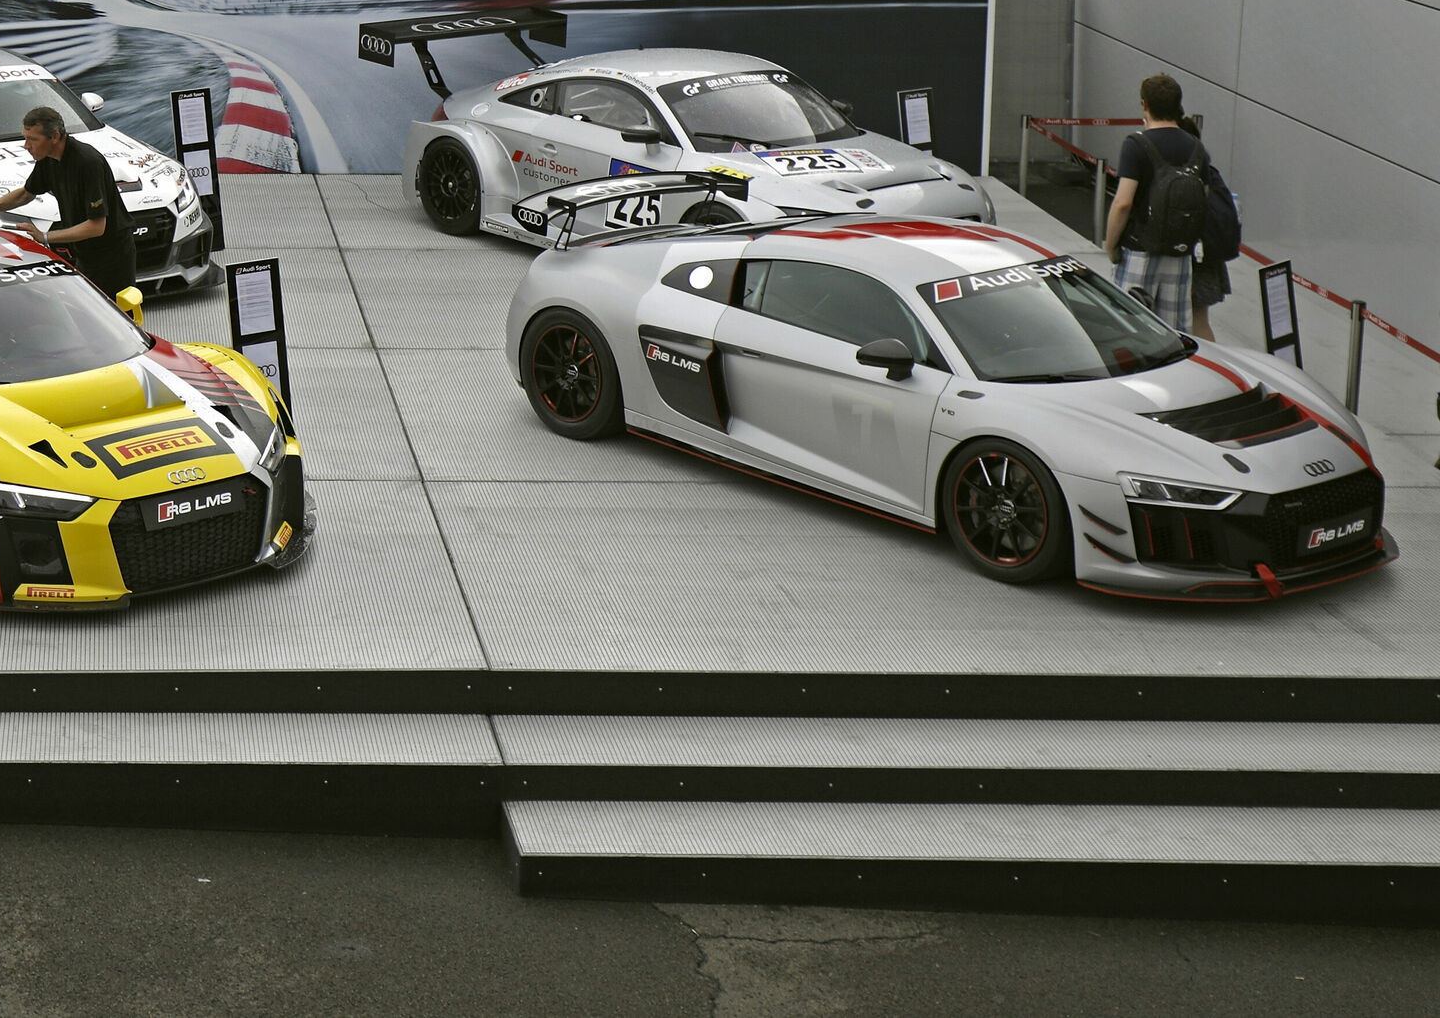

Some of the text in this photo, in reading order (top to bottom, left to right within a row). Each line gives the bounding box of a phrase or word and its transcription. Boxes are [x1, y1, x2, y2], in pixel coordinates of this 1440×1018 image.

[622, 73, 656, 94] Hohenadel
[706, 78, 732, 88] GRAN
[731, 74, 769, 84] TURISMO
[524, 154, 578, 176] Audi Sport
[775, 155, 847, 172] 225
[614, 195, 660, 226] 225
[256, 264, 271, 272] Sport
[968, 258, 1087, 291] Audi Sport
[652, 350, 700, 372] R8 LMS
[116, 431, 204, 460] PIRELLI
[167, 492, 232, 519] R8 LMS
[1316, 520, 1364, 544] R8 LMS
[26, 586, 76, 598] PIRELLI
